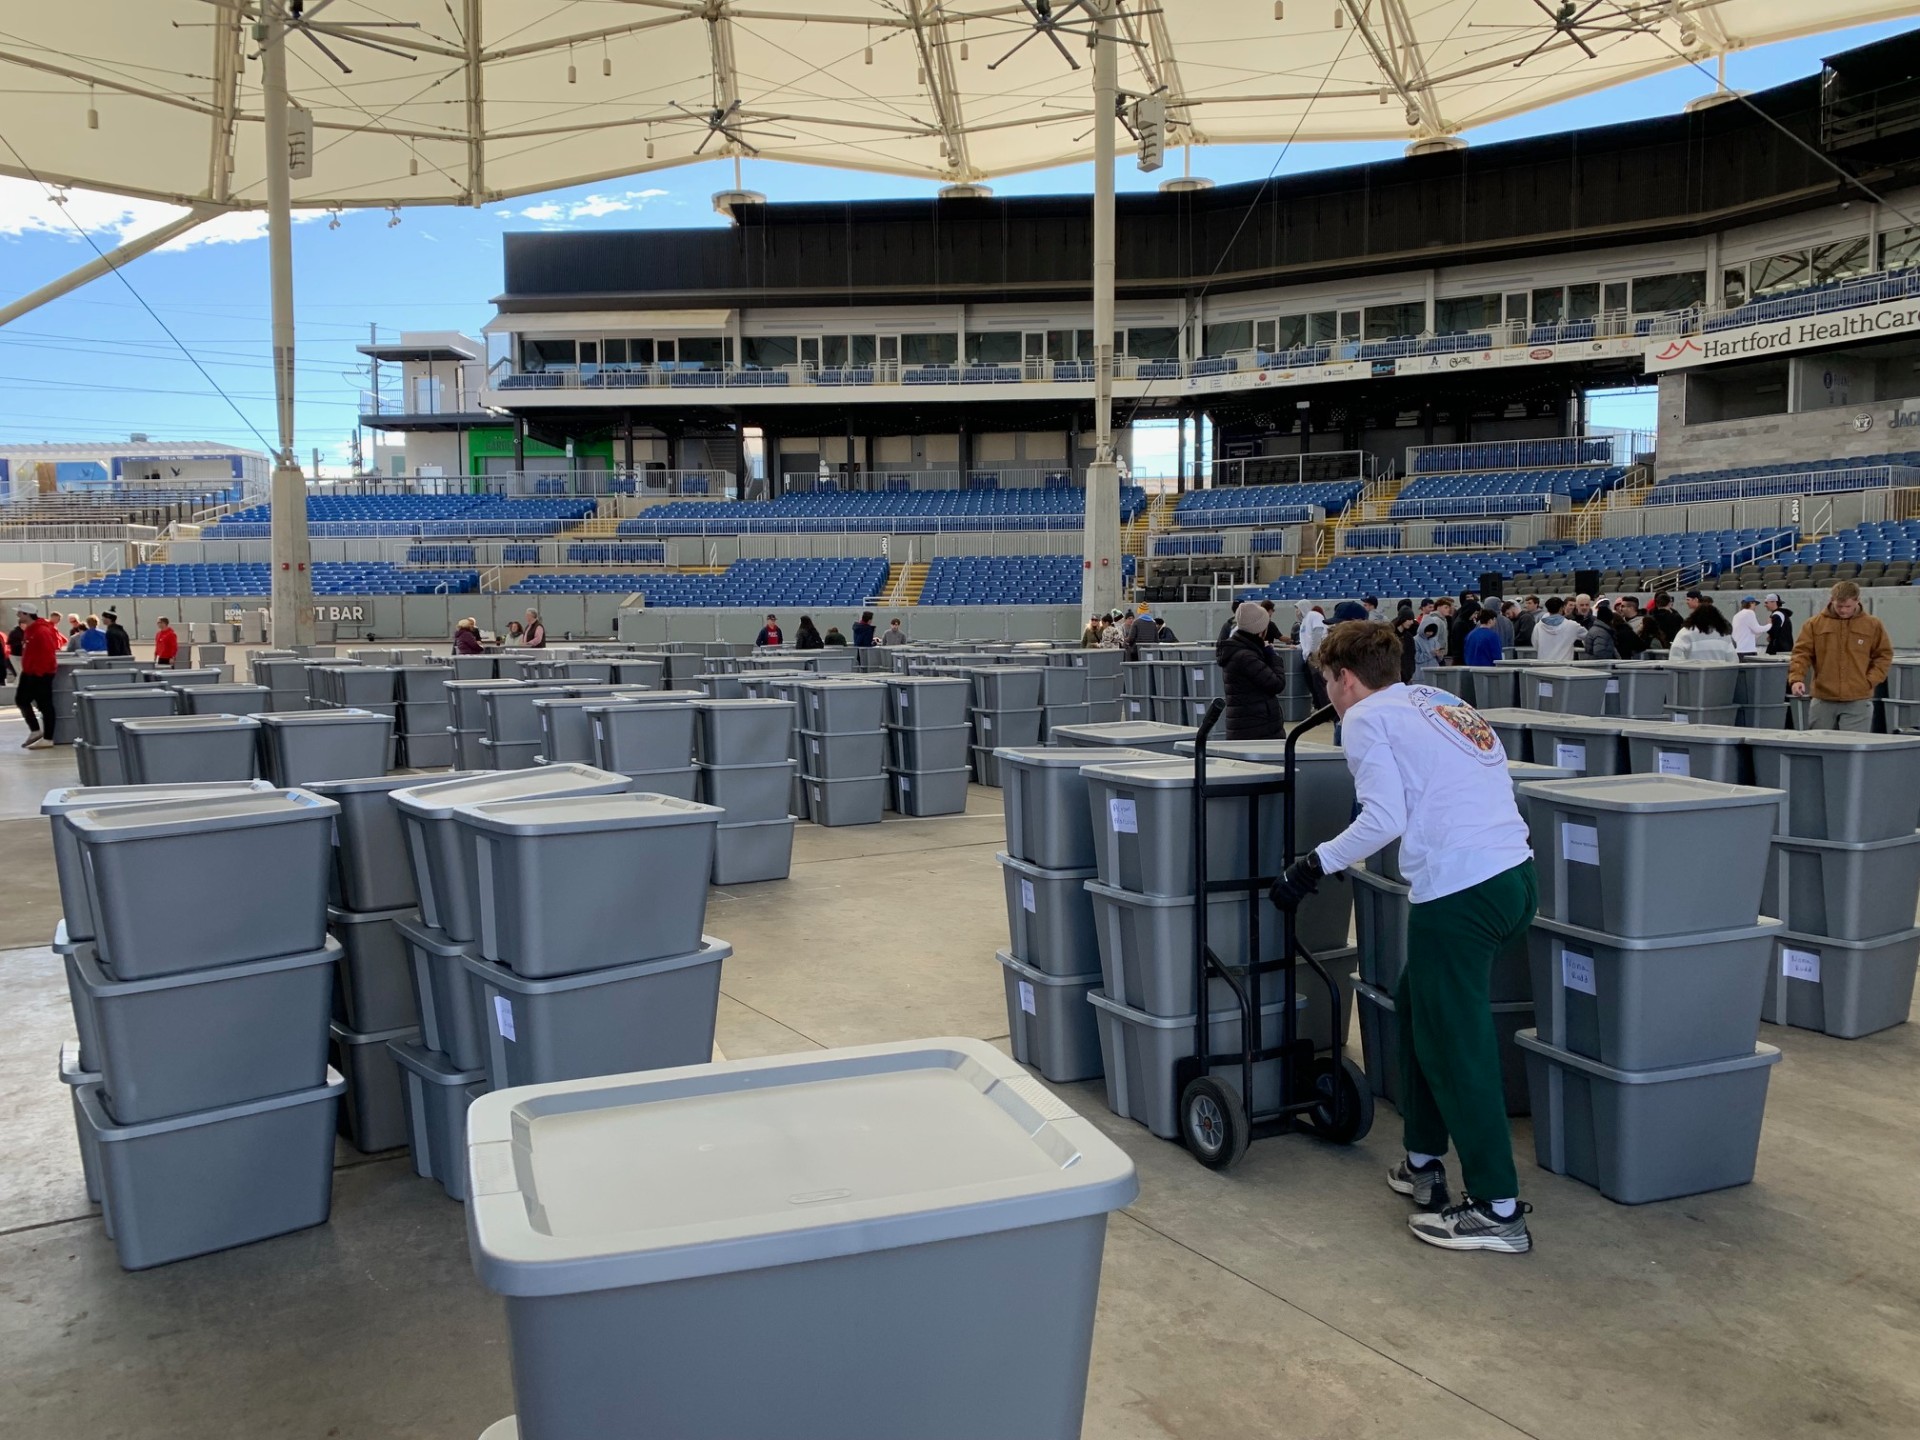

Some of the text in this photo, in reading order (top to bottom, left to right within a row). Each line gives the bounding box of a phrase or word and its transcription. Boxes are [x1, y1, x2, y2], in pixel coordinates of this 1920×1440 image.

[1702, 309, 1920, 358] Hartford HealthCar
[1888, 409, 1920, 429] JAC
[1791, 499, 1800, 522] 204
[329, 606, 364, 620] BAR
